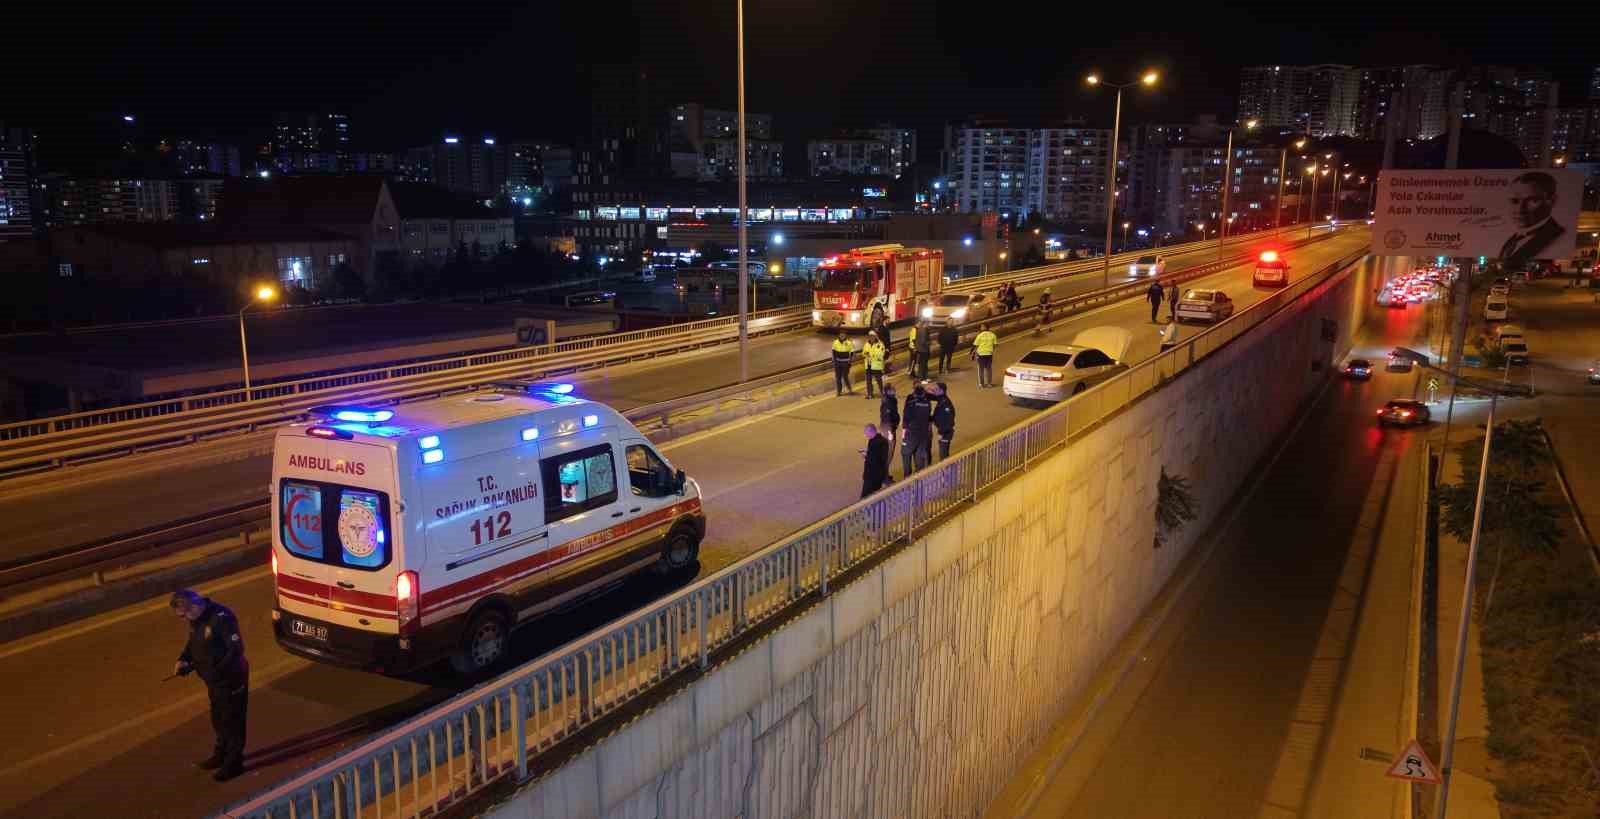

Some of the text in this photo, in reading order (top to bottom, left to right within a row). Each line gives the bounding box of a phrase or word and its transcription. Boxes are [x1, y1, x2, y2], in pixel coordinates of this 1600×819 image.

[1390, 175, 1509, 188] Dinlenmemek Üzere
[1390, 191, 1464, 202] Yola Çıkanlar
[1387, 205, 1488, 217] Asla Yorulmazlar.
[1425, 231, 1461, 242] Ahmet
[288, 454, 366, 476] AMBULANS
[477, 475, 498, 493] T.C.
[293, 511, 321, 533] 112
[470, 511, 512, 546] 112
